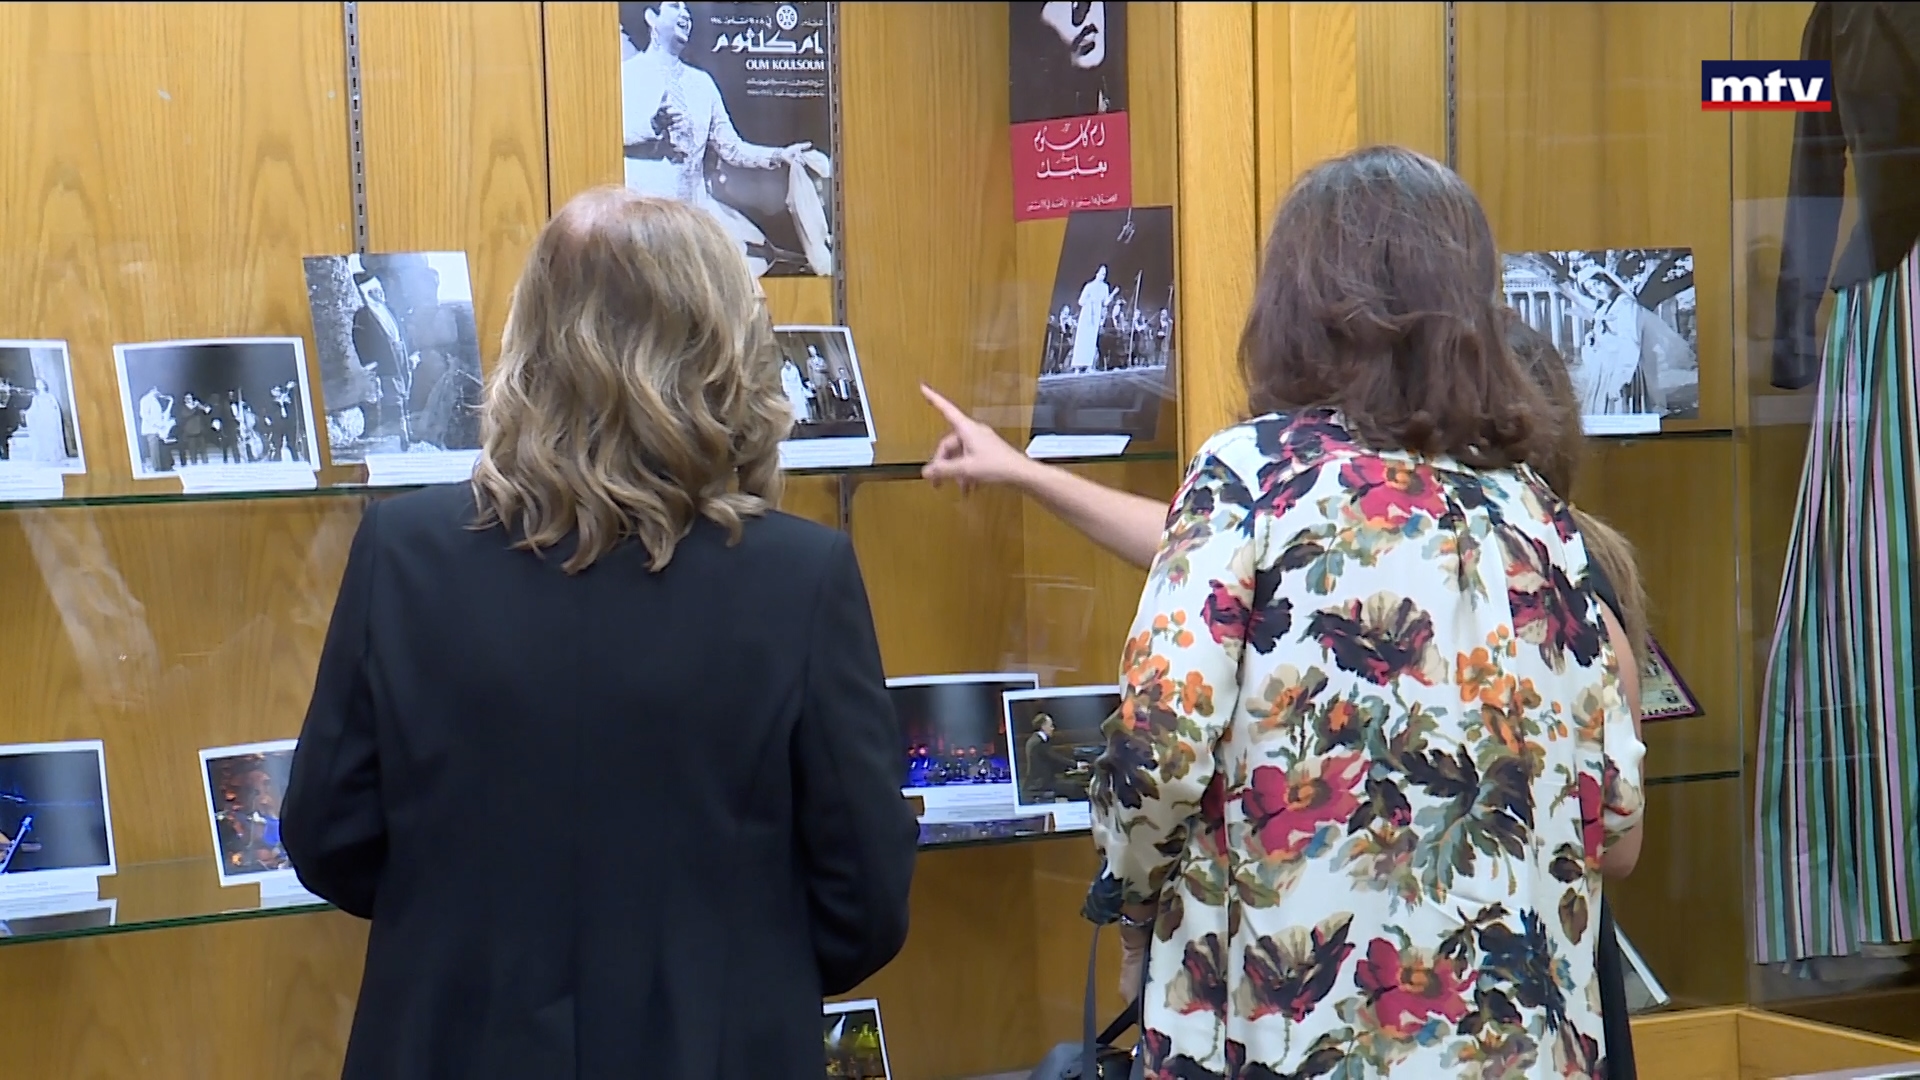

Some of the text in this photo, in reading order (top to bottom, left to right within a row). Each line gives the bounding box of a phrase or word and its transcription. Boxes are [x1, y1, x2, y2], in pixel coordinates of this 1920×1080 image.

[745, 59, 825, 70] OUM KOULSOUM
[1036, 154, 1108, 180] بعلبك
